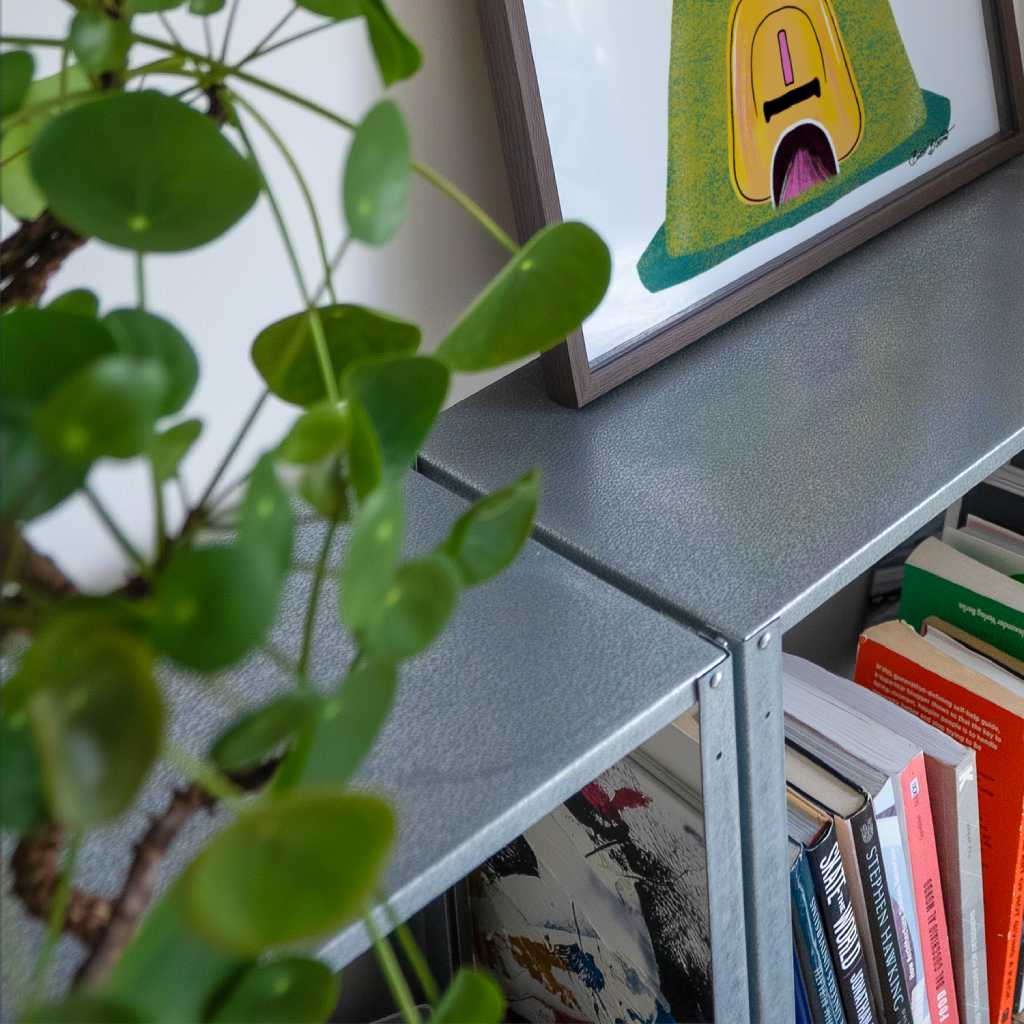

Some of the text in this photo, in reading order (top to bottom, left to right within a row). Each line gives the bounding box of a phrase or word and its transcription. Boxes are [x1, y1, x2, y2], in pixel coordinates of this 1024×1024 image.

[820, 841, 862, 971] SKATE THE WORLD
[866, 847, 889, 927] STEPHEN
[881, 924, 905, 1012] HAWKING
[936, 990, 950, 1023] FOOD
